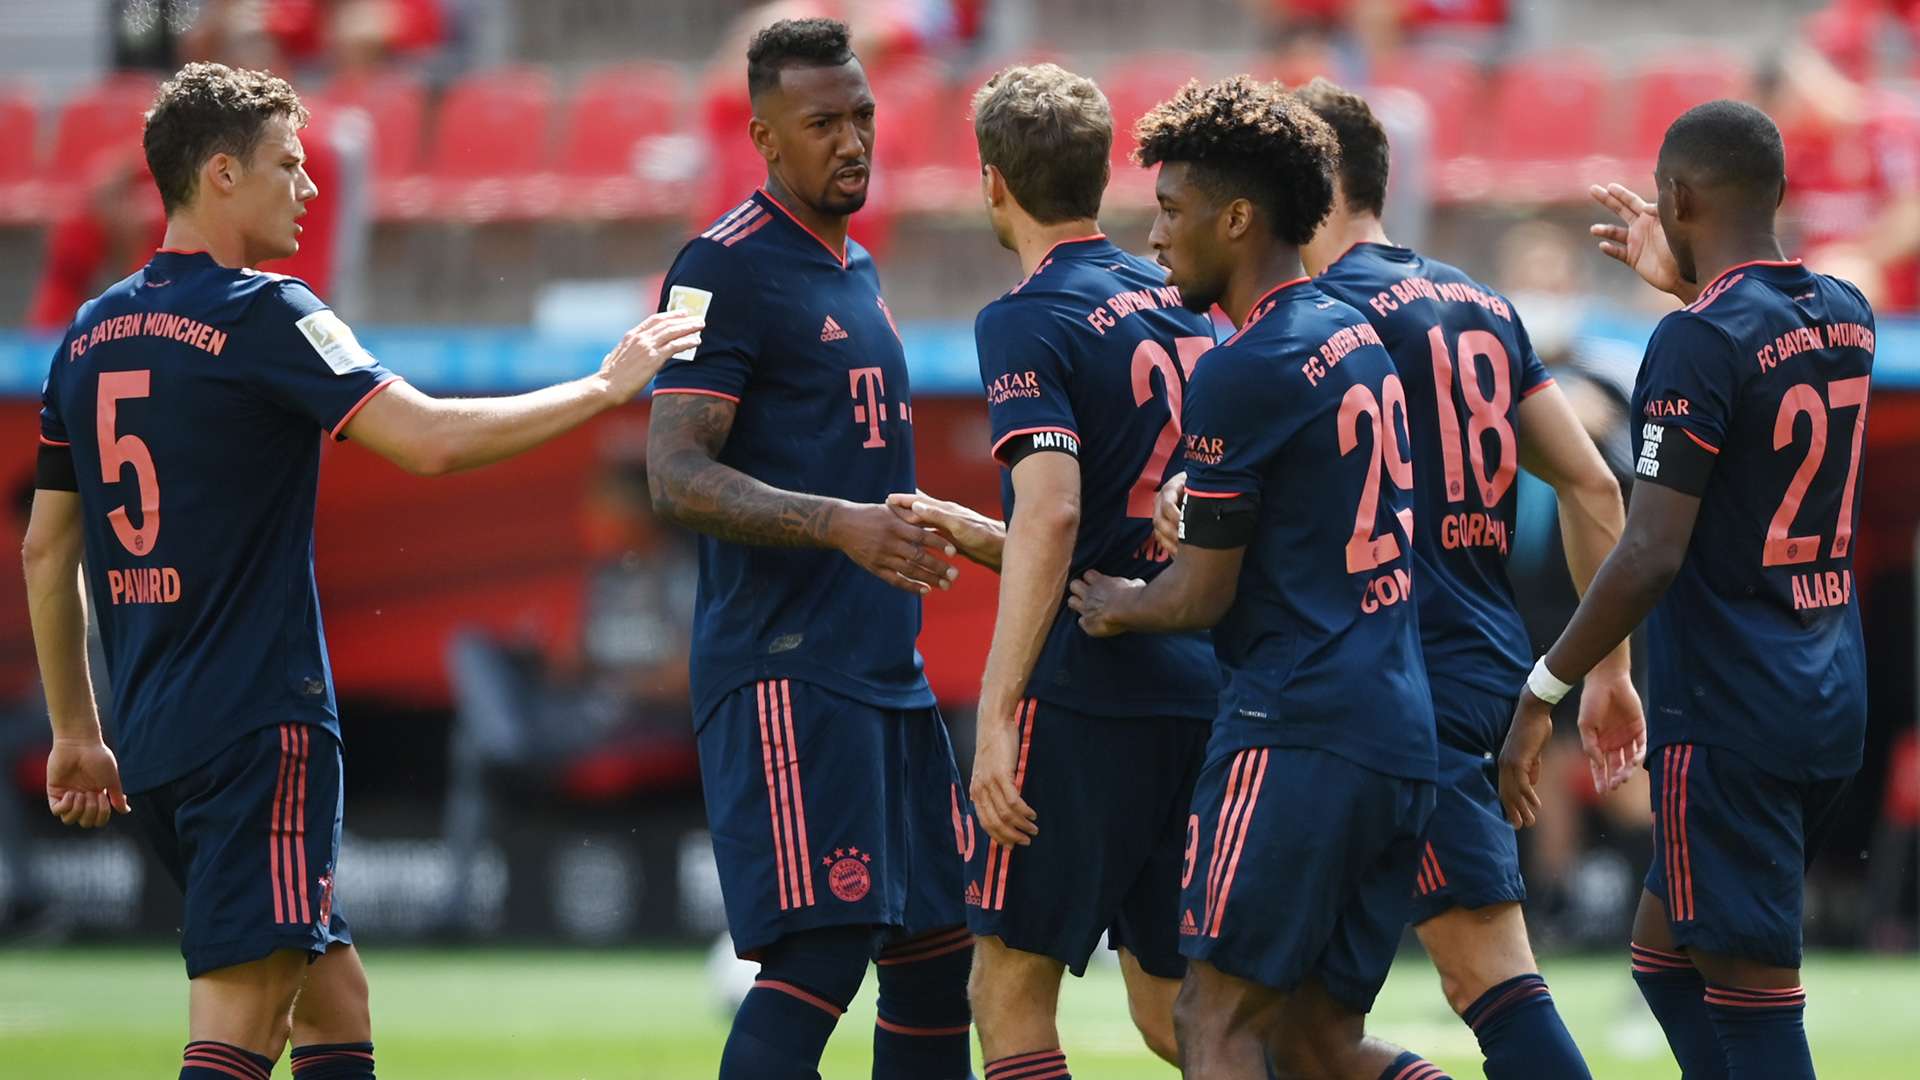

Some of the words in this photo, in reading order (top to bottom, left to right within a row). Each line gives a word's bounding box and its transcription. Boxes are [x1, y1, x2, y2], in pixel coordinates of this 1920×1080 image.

[1087, 307, 1116, 335] FC
[1369, 292, 1399, 317] FC
[70, 334, 88, 362] FC
[89, 313, 143, 349] BAYERN
[1302, 356, 1326, 387] FC
[1757, 344, 1777, 374] FC
[1427, 325, 1519, 508] 18
[96, 369, 160, 556] 5
[1336, 373, 1415, 575] 29
[1762, 374, 1871, 567] 27
[107, 567, 181, 605] PAVARD
[1791, 570, 1850, 610] ALABA
